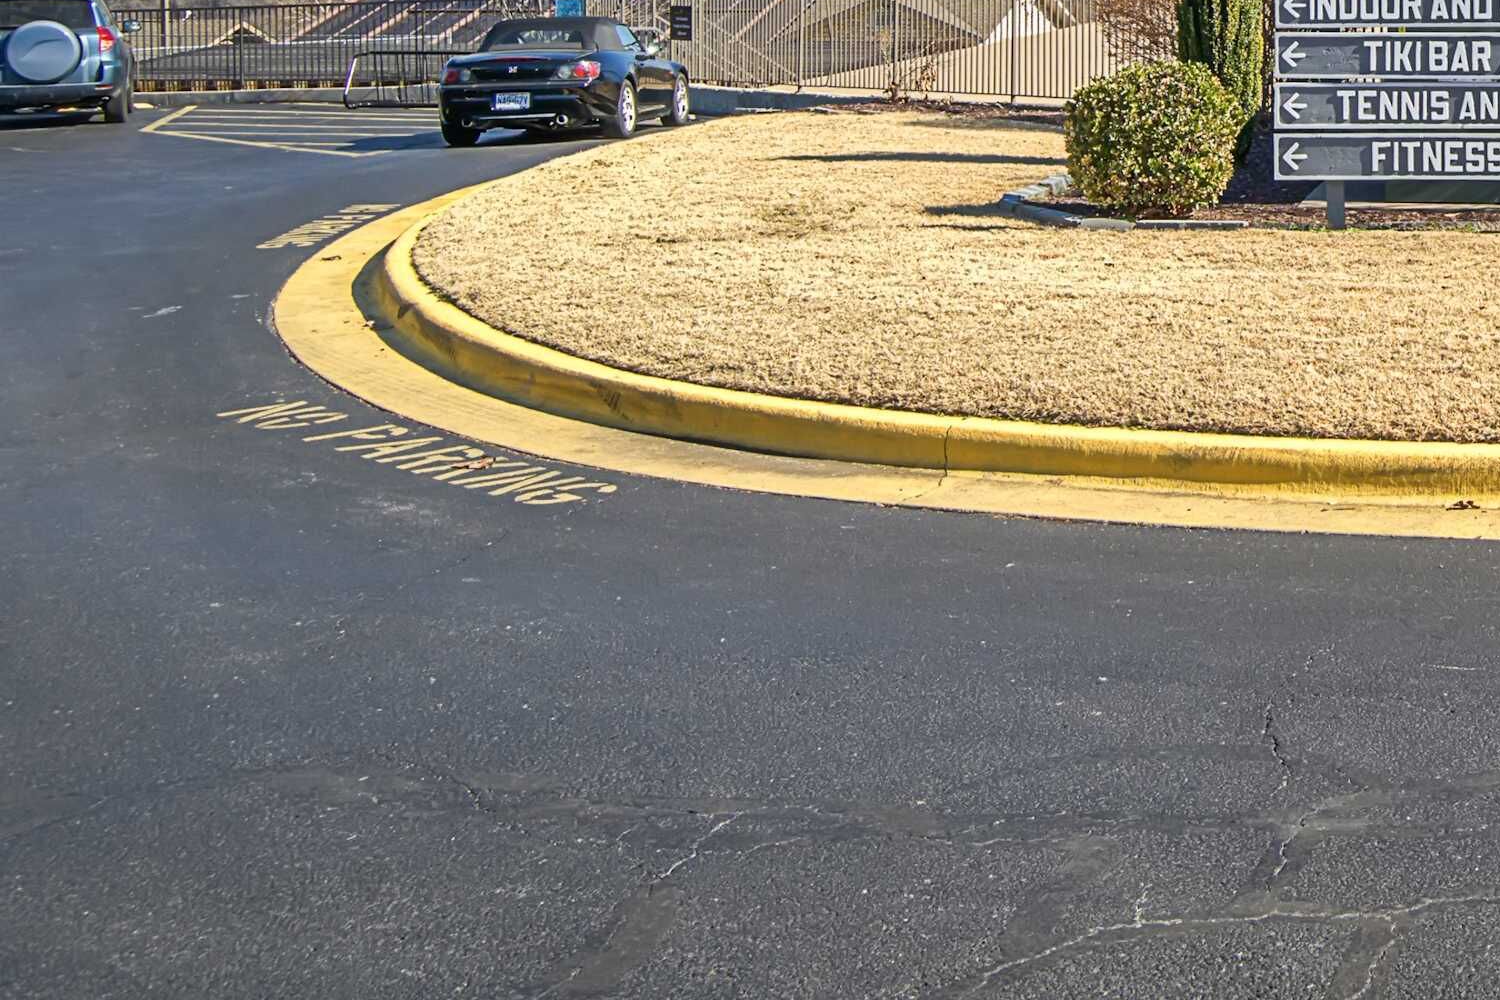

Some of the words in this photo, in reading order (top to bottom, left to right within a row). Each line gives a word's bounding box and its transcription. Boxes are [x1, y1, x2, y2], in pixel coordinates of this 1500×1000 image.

[1363, 40, 1422, 72] TIKI
[1428, 40, 1492, 72] BAR
[1336, 89, 1450, 121] TENNIS
[216, 400, 349, 430] NO
[302, 423, 617, 505] PARKING
